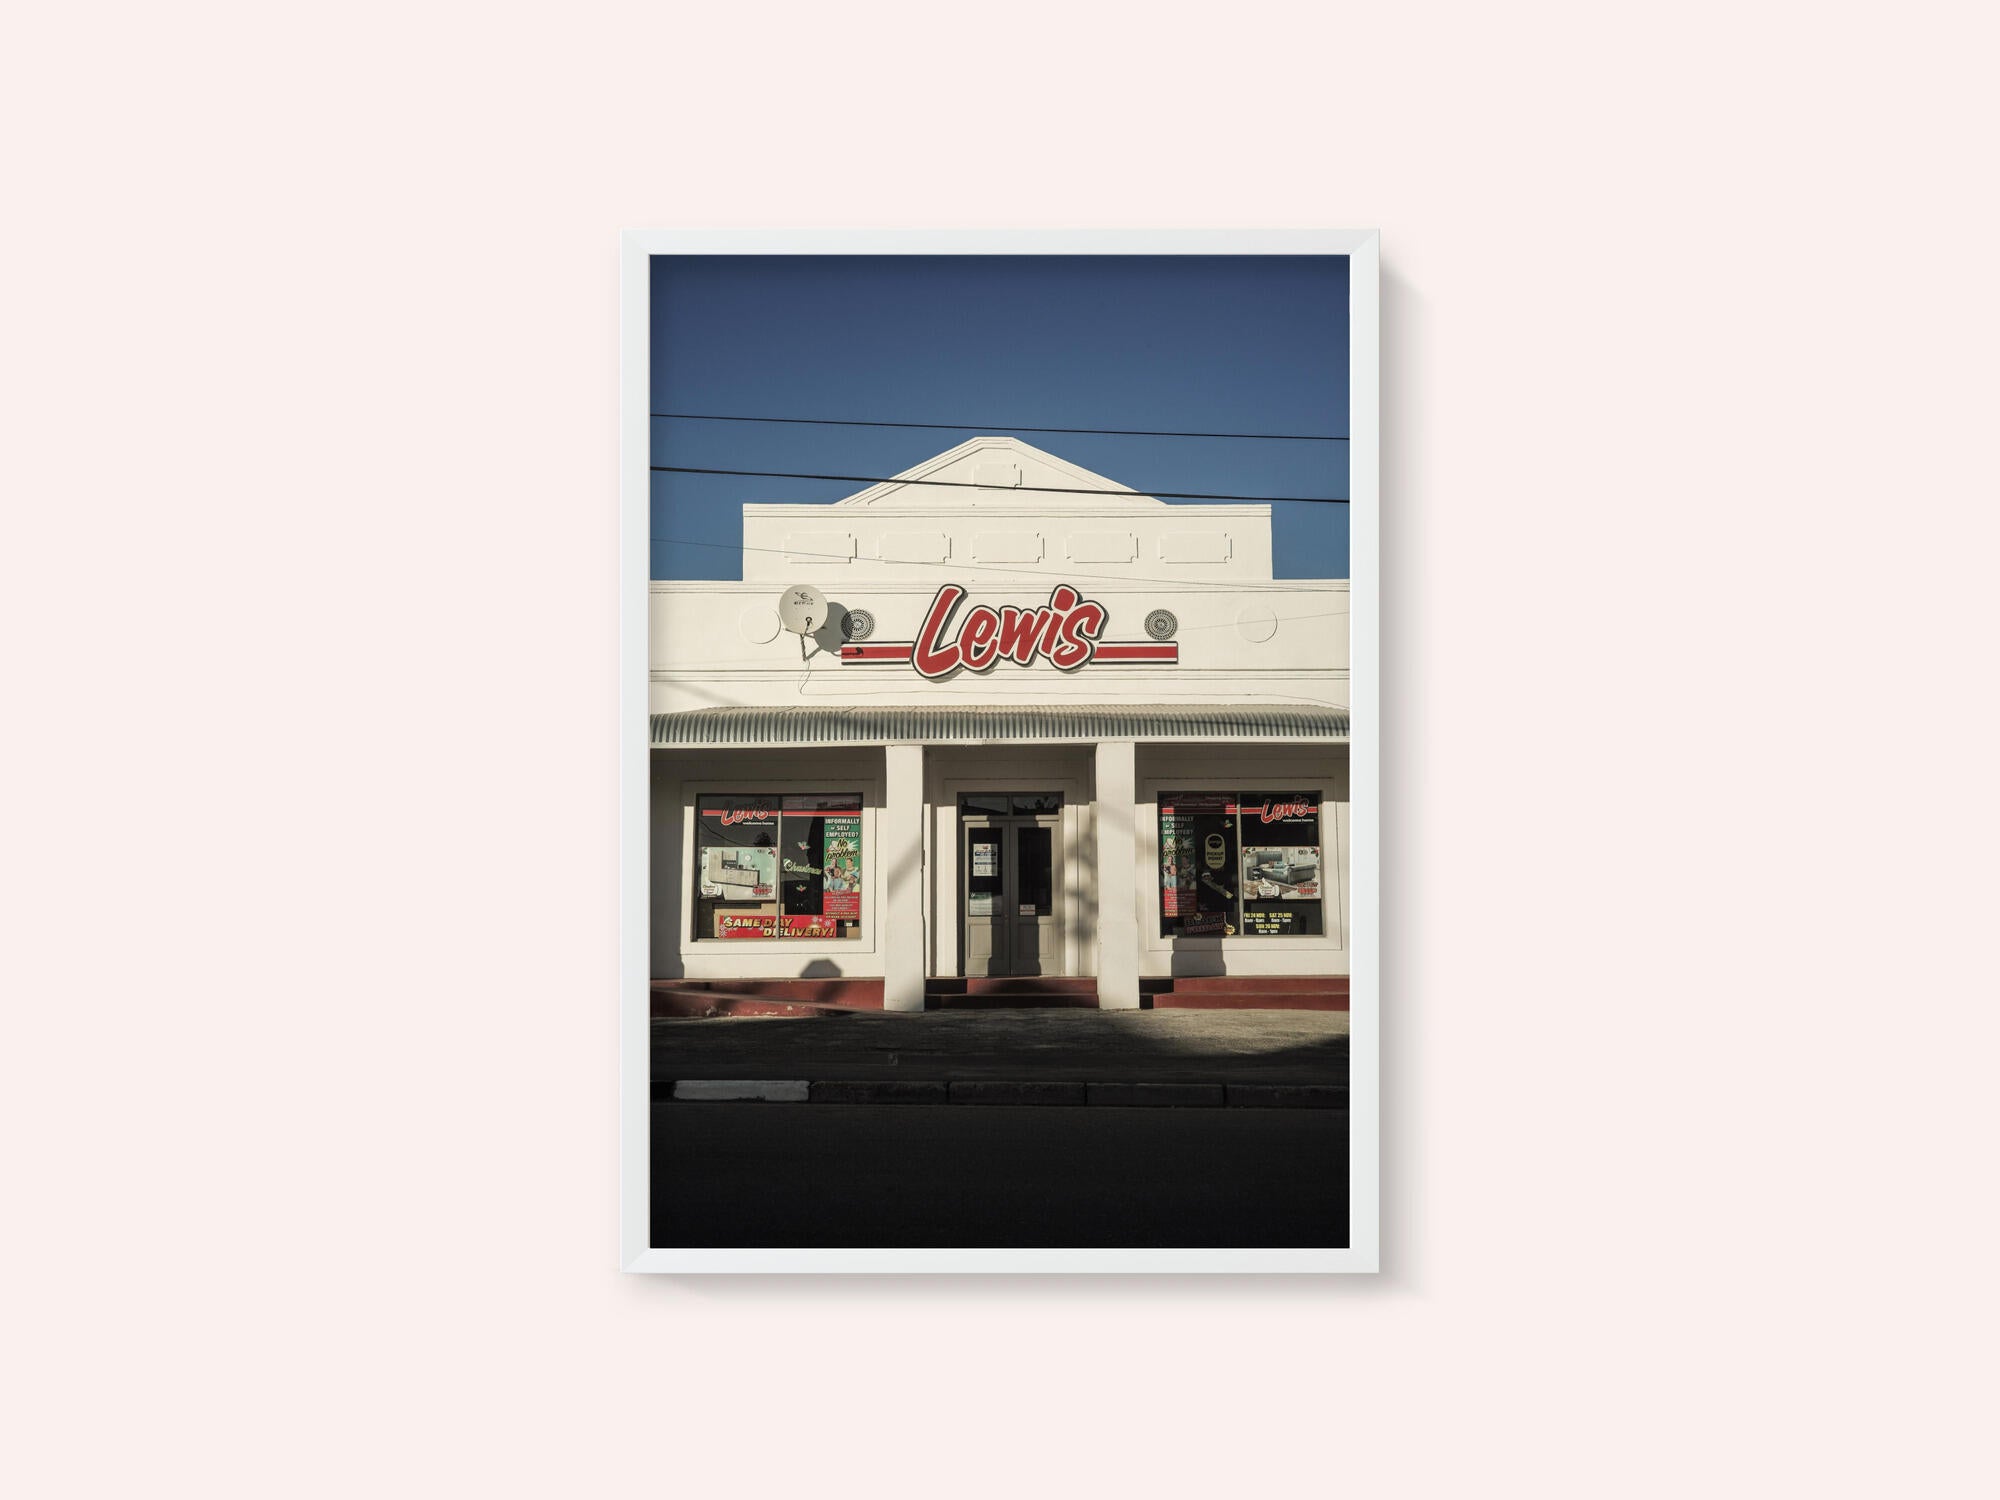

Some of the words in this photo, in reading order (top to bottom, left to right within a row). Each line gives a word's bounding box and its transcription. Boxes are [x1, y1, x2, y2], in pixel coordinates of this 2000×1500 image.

[912, 584, 1109, 679] Lewis
[1261, 796, 1309, 823] Lewis
[837, 838, 848, 848] No
[725, 917, 761, 928] SAME
